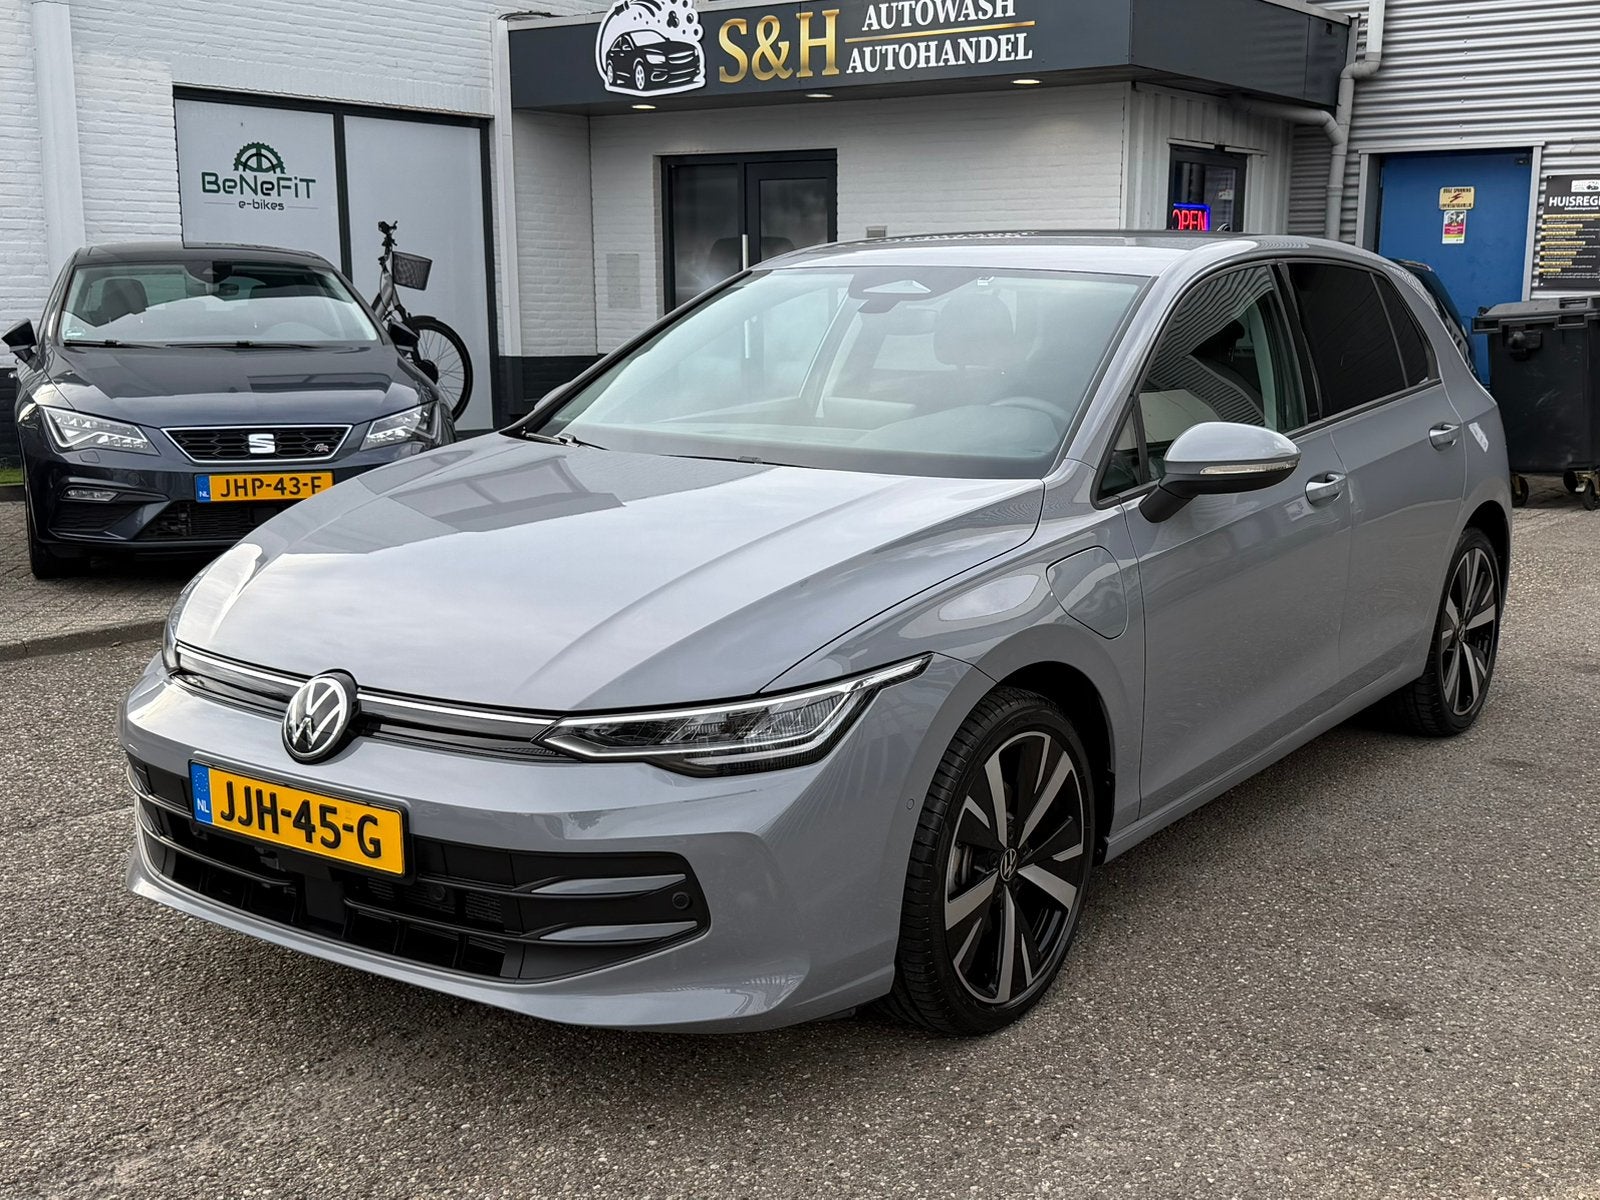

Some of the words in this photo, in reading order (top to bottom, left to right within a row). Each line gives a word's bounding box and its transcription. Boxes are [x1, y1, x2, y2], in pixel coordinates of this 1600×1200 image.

[861, 0, 1016, 31] AUTOWASH
[718, 9, 841, 83] S&H
[846, 33, 1033, 74] AUTOHANDEL
[238, 199, 285, 211] e-bikes
[1548, 195, 1600, 207] HUISREG
[1172, 209, 1208, 231] OPEN
[199, 490, 210, 498] NL
[220, 476, 322, 498] JHP-43-F
[196, 798, 210, 814] NL
[220, 780, 383, 860] JJH-45-G
